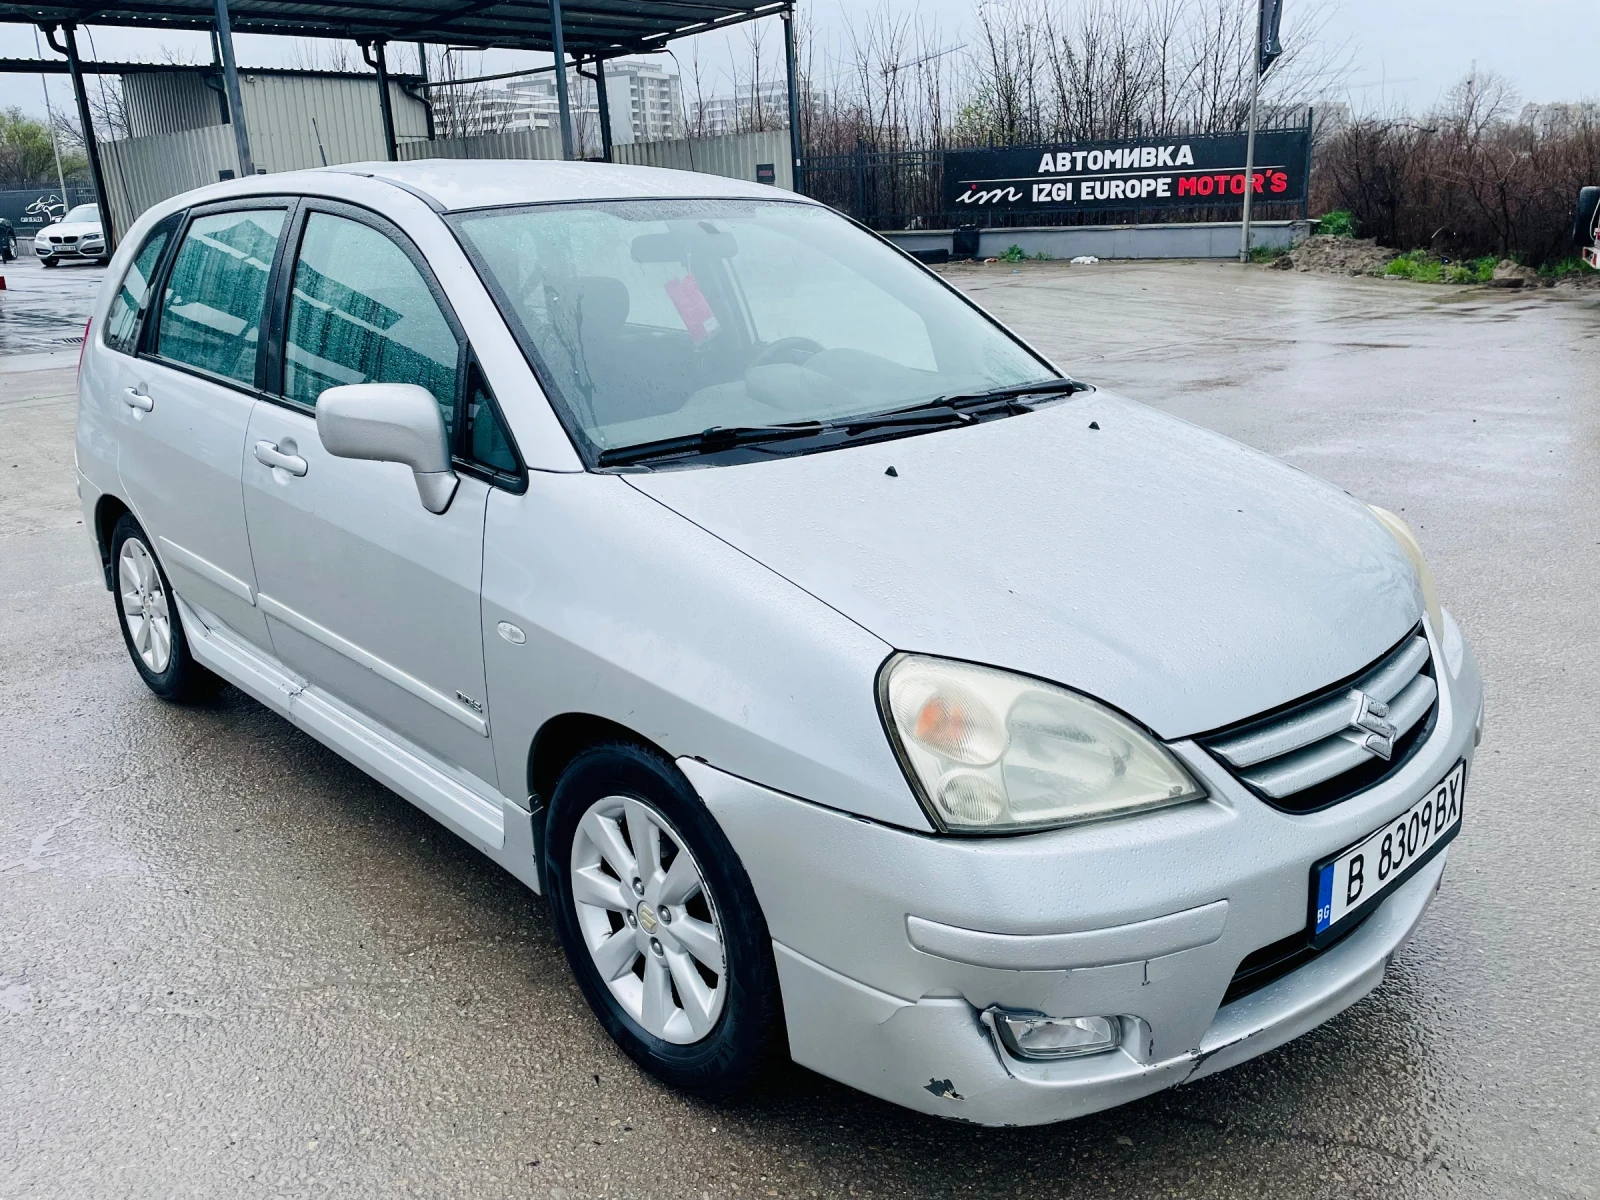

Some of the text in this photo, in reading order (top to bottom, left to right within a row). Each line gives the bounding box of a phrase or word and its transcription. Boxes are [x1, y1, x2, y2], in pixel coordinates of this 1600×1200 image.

[1037, 144, 1195, 173] АВТОМИВКА
[1032, 169, 1288, 202] IZGI EUROPE MOTOR'S
[1346, 853, 1365, 908] B
[1317, 904, 1330, 923] BG
